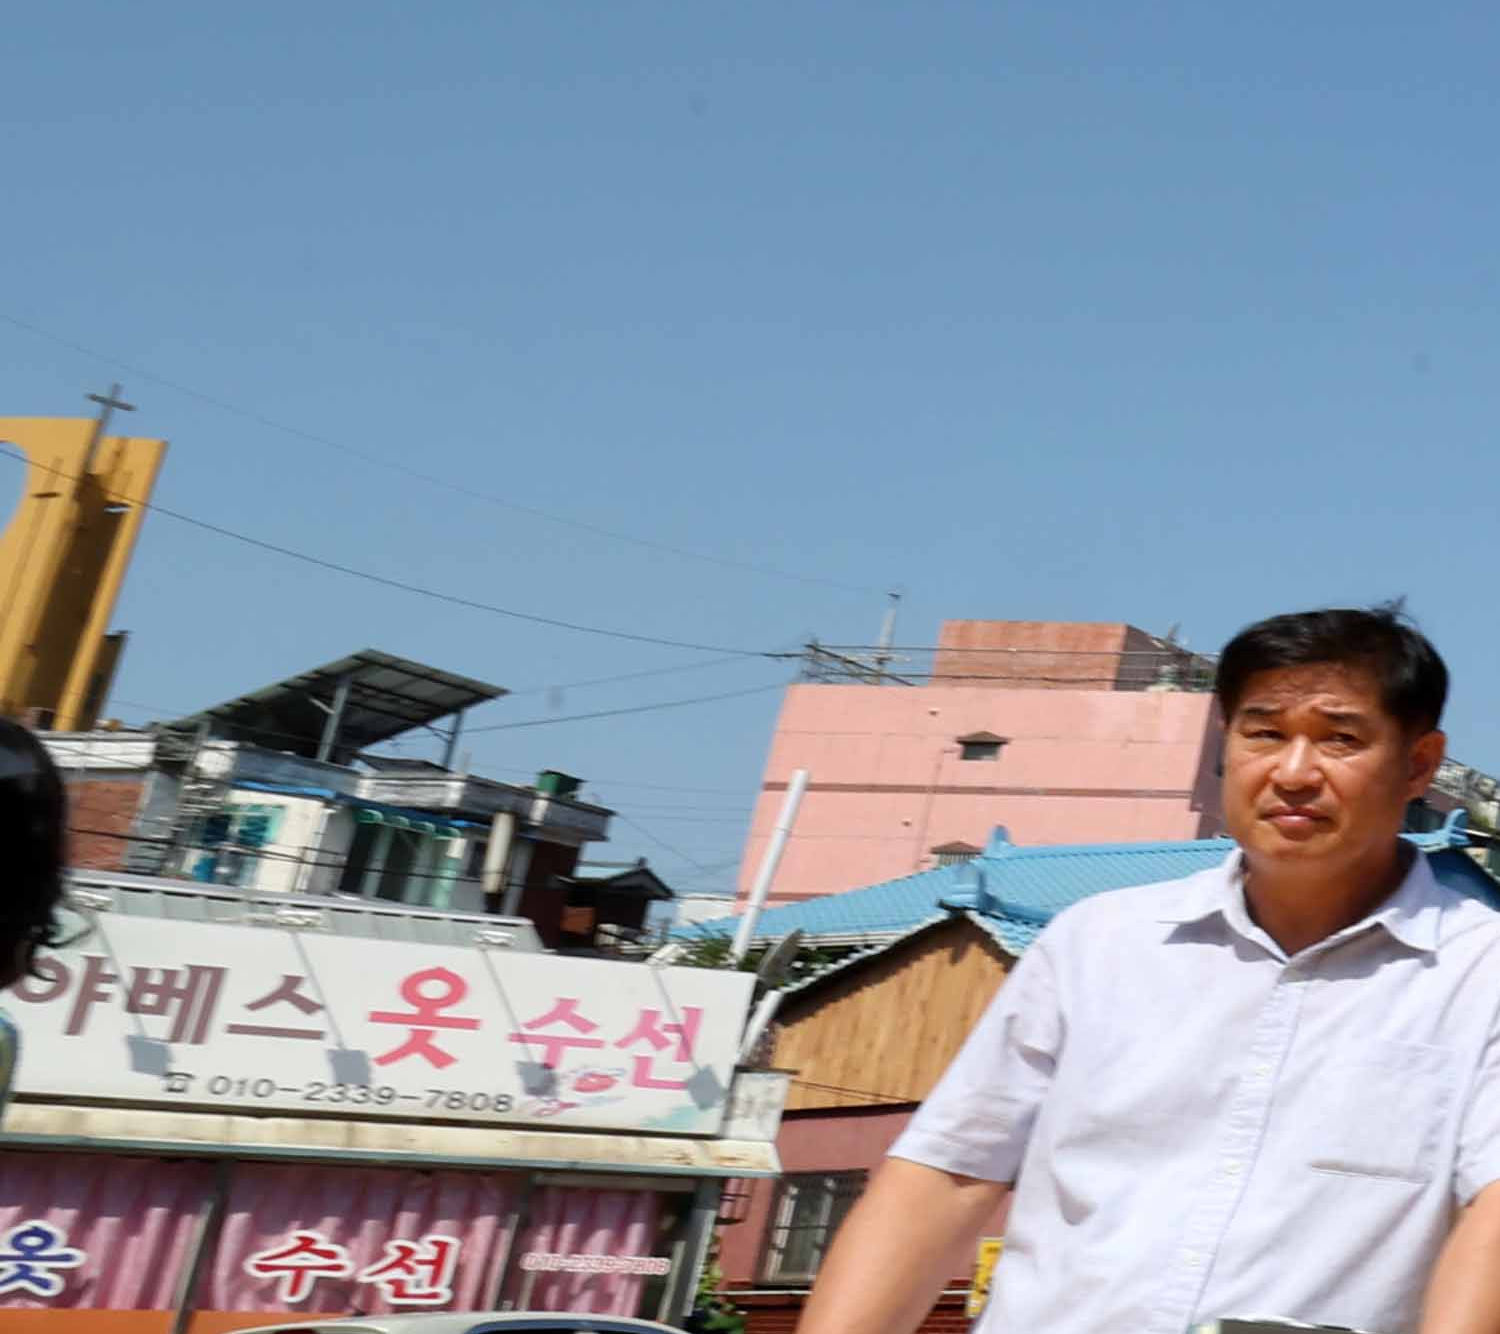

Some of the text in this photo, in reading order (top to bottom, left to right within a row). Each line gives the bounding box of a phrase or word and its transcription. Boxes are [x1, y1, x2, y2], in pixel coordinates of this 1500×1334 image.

[12, 954, 705, 1091] 야베스 옷 수선
[207, 1074, 514, 1115] 010-2339-7808
[0, 1222, 461, 1304] 옷 수선
